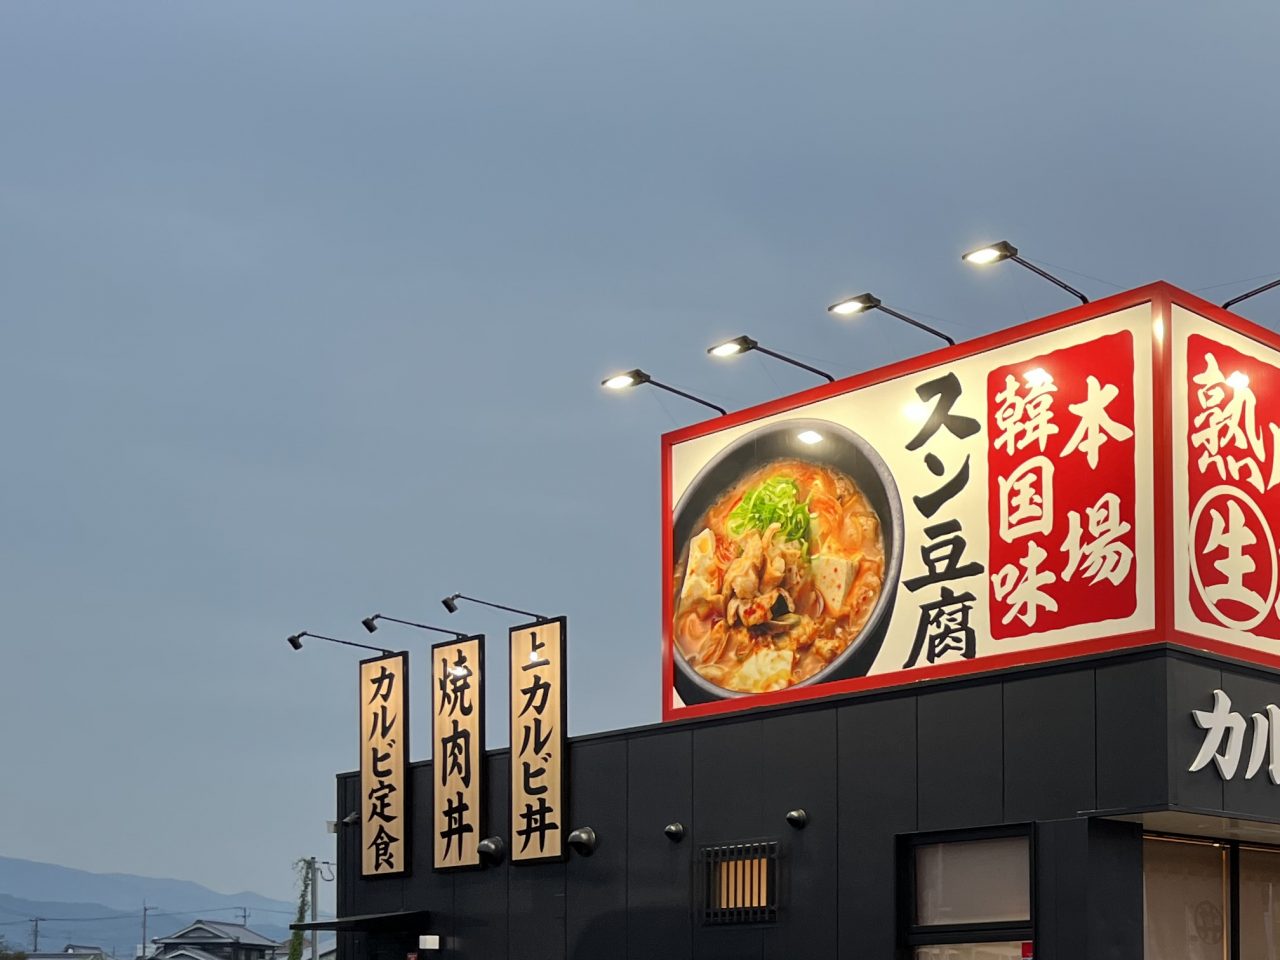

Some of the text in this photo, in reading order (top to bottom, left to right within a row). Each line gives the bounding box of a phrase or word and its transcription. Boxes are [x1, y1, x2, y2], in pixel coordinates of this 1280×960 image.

[901, 371, 985, 669] スン豆腐
[991, 367, 1059, 627] 韓国味
[1060, 376, 1134, 587] 本場
[367, 665, 400, 873] カルビ定食
[438, 648, 474, 862] 焼肉丼
[516, 631, 559, 854] 上カルビ丼
